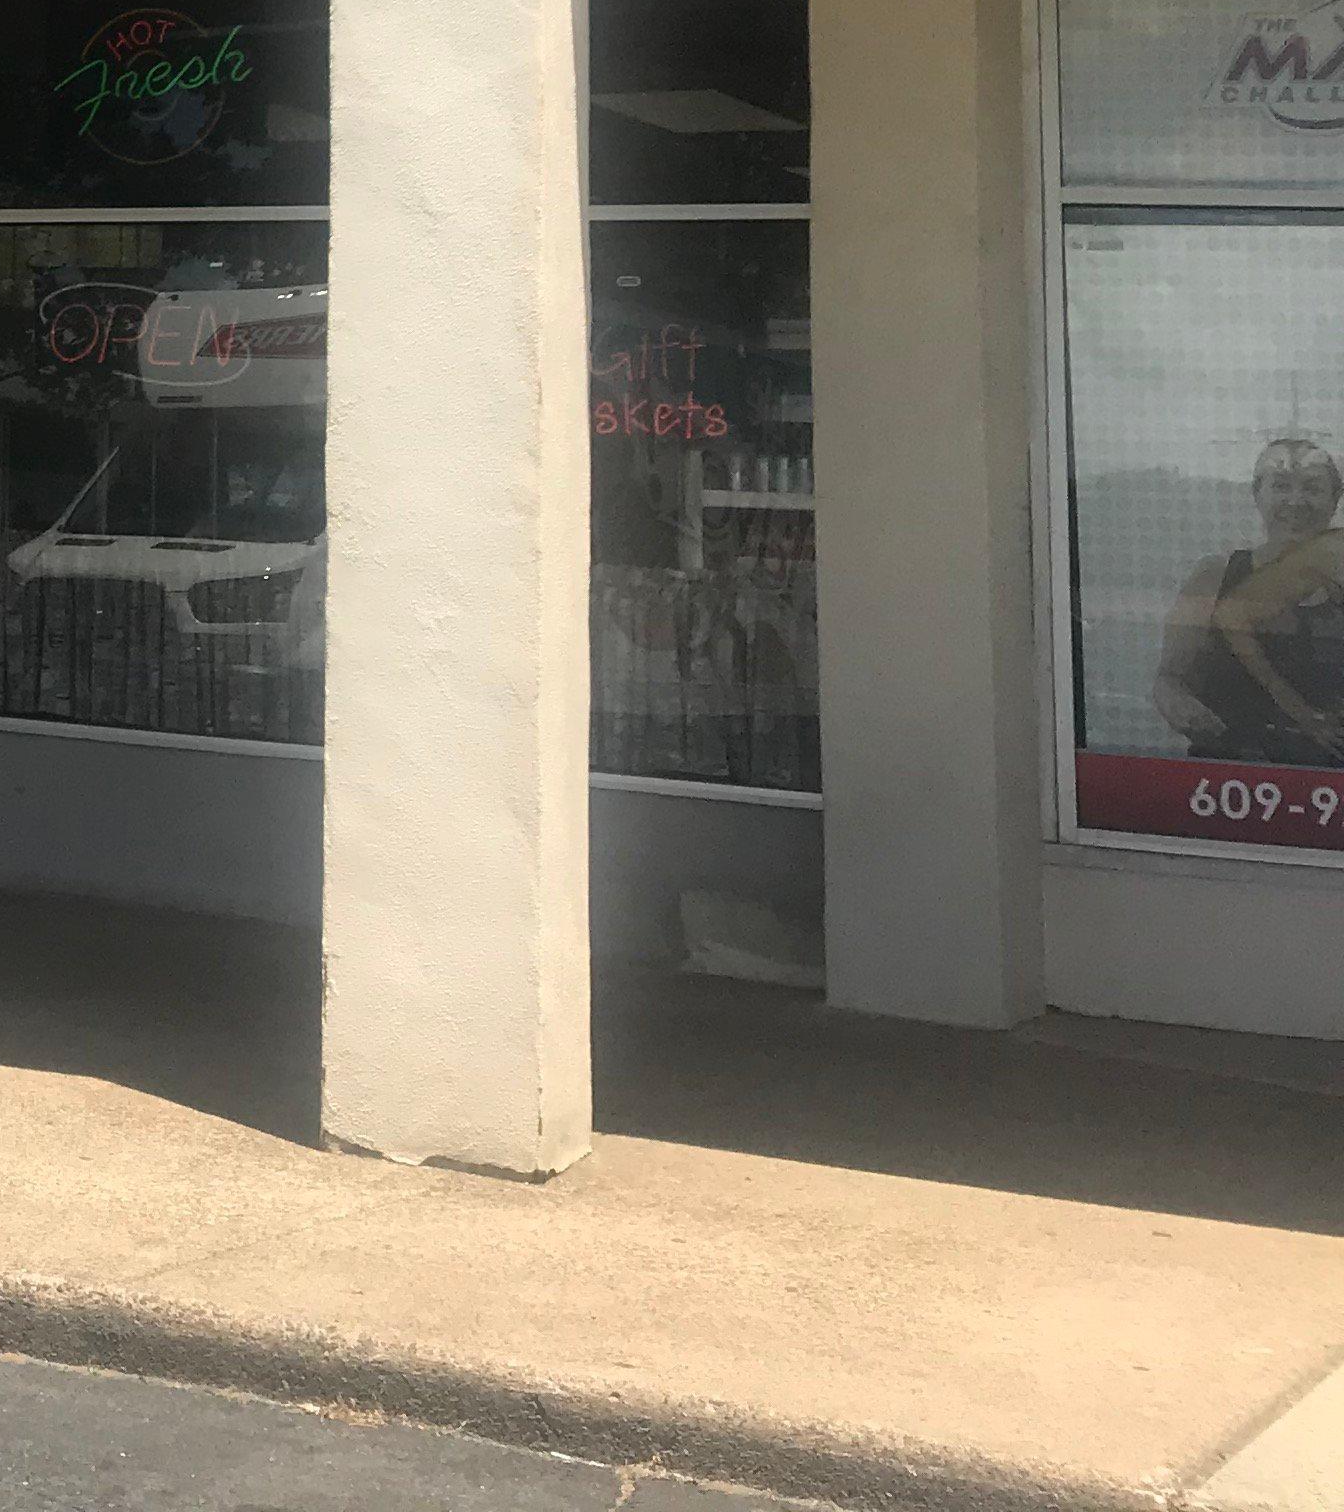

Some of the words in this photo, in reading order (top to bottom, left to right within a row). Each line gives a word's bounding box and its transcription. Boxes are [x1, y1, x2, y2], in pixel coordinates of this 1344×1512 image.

[106, 19, 176, 62] HOT
[53, 24, 254, 136] Fresh
[50, 304, 237, 366] OPEN
[1189, 777, 1344, 826] 609-9
